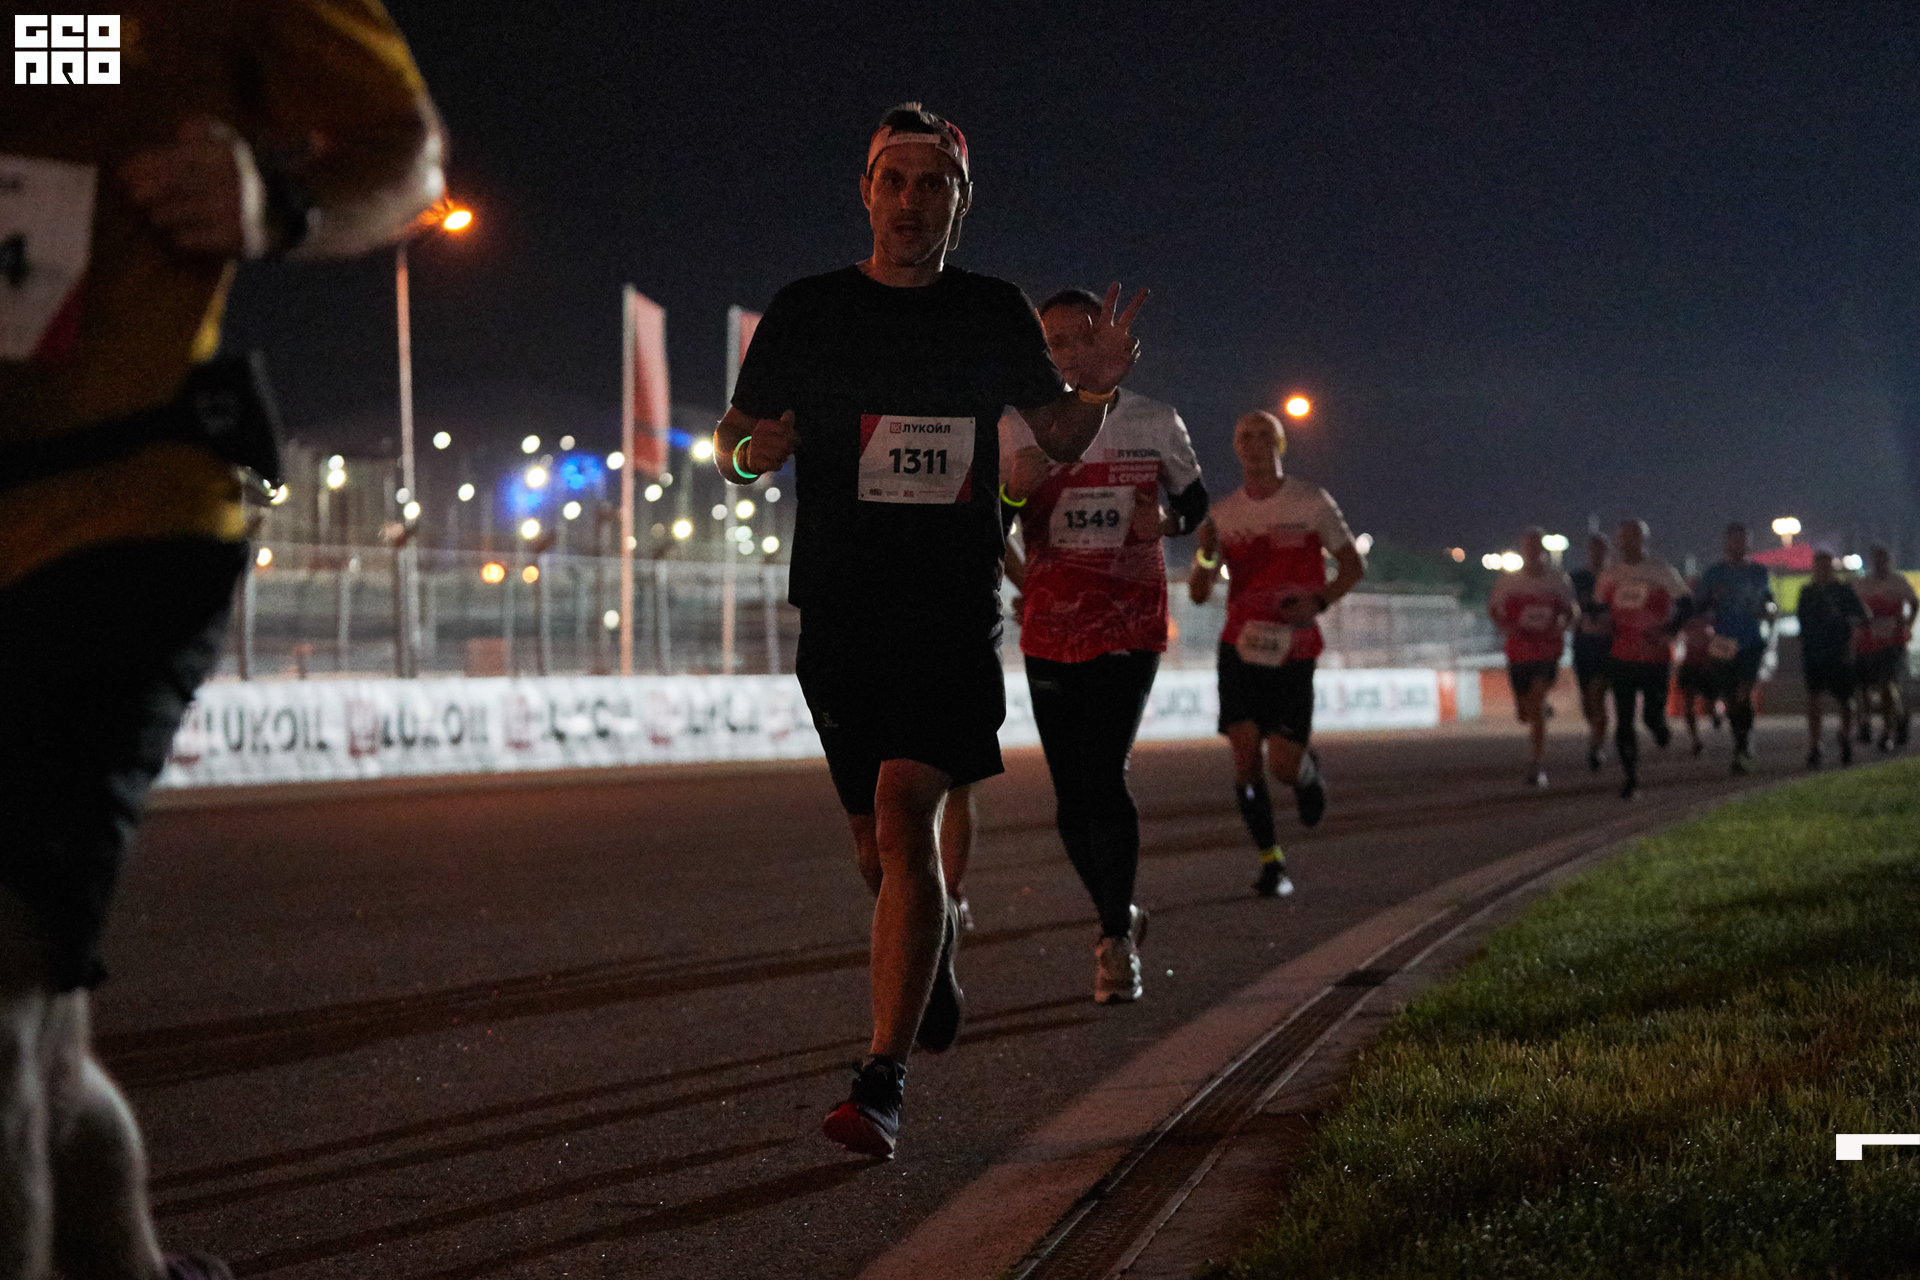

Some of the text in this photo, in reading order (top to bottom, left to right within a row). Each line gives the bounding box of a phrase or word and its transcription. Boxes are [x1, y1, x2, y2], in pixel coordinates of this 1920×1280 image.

[902, 423, 951, 434] ЛУКОЙЛ
[889, 448, 947, 475] 1311
[1064, 508, 1120, 528] 1349
